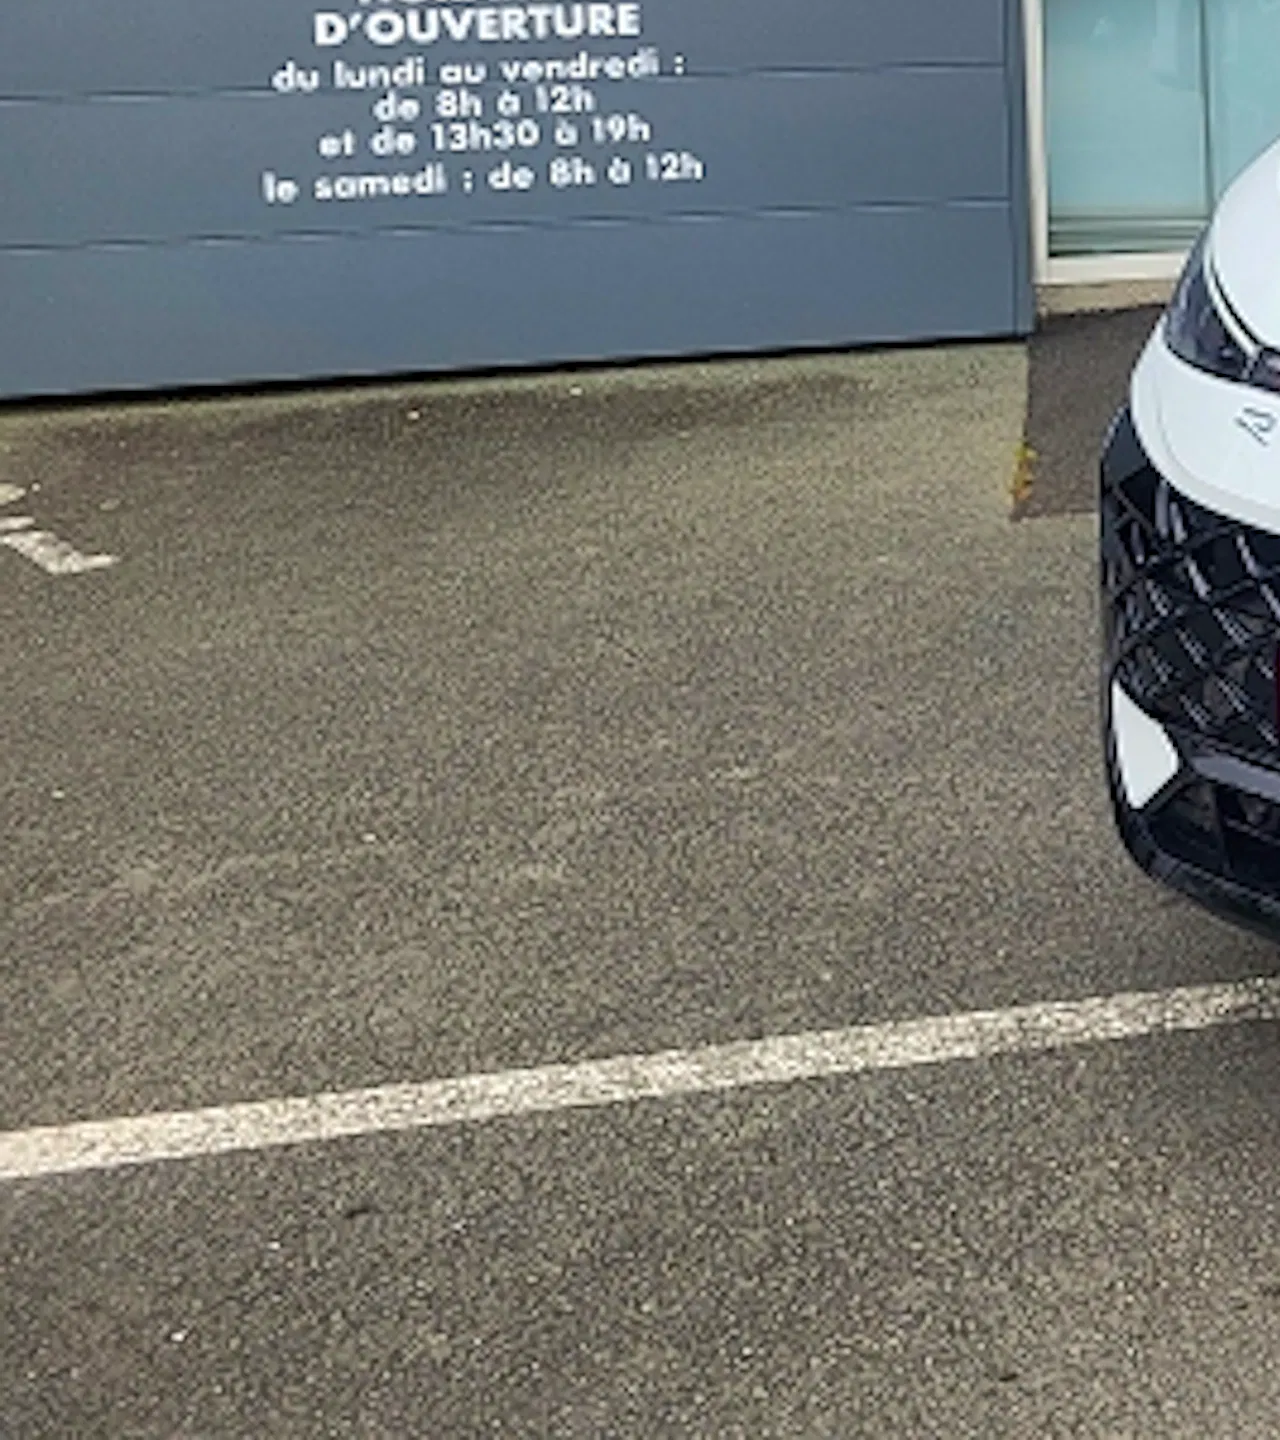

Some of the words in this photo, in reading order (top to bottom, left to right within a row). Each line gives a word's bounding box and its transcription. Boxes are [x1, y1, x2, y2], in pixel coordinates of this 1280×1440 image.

[314, 3, 641, 47] D'OUVERTURE
[271, 60, 319, 93] du
[333, 55, 426, 91] lundi
[439, 62, 487, 87] au
[500, 48, 661, 85] vendredi
[373, 91, 421, 123] de
[436, 88, 483, 119] 8h
[497, 86, 521, 117] à
[535, 83, 594, 115] 12h
[317, 128, 355, 159] et
[370, 125, 417, 158] de
[430, 117, 541, 153] 13h30
[553, 116, 579, 147] à
[593, 112, 652, 144] 19h
[261, 171, 300, 206] le
[313, 163, 448, 202] samedi
[488, 160, 535, 192] de
[549, 157, 595, 189] 8h
[607, 156, 632, 185] à
[645, 152, 705, 182] 12h
